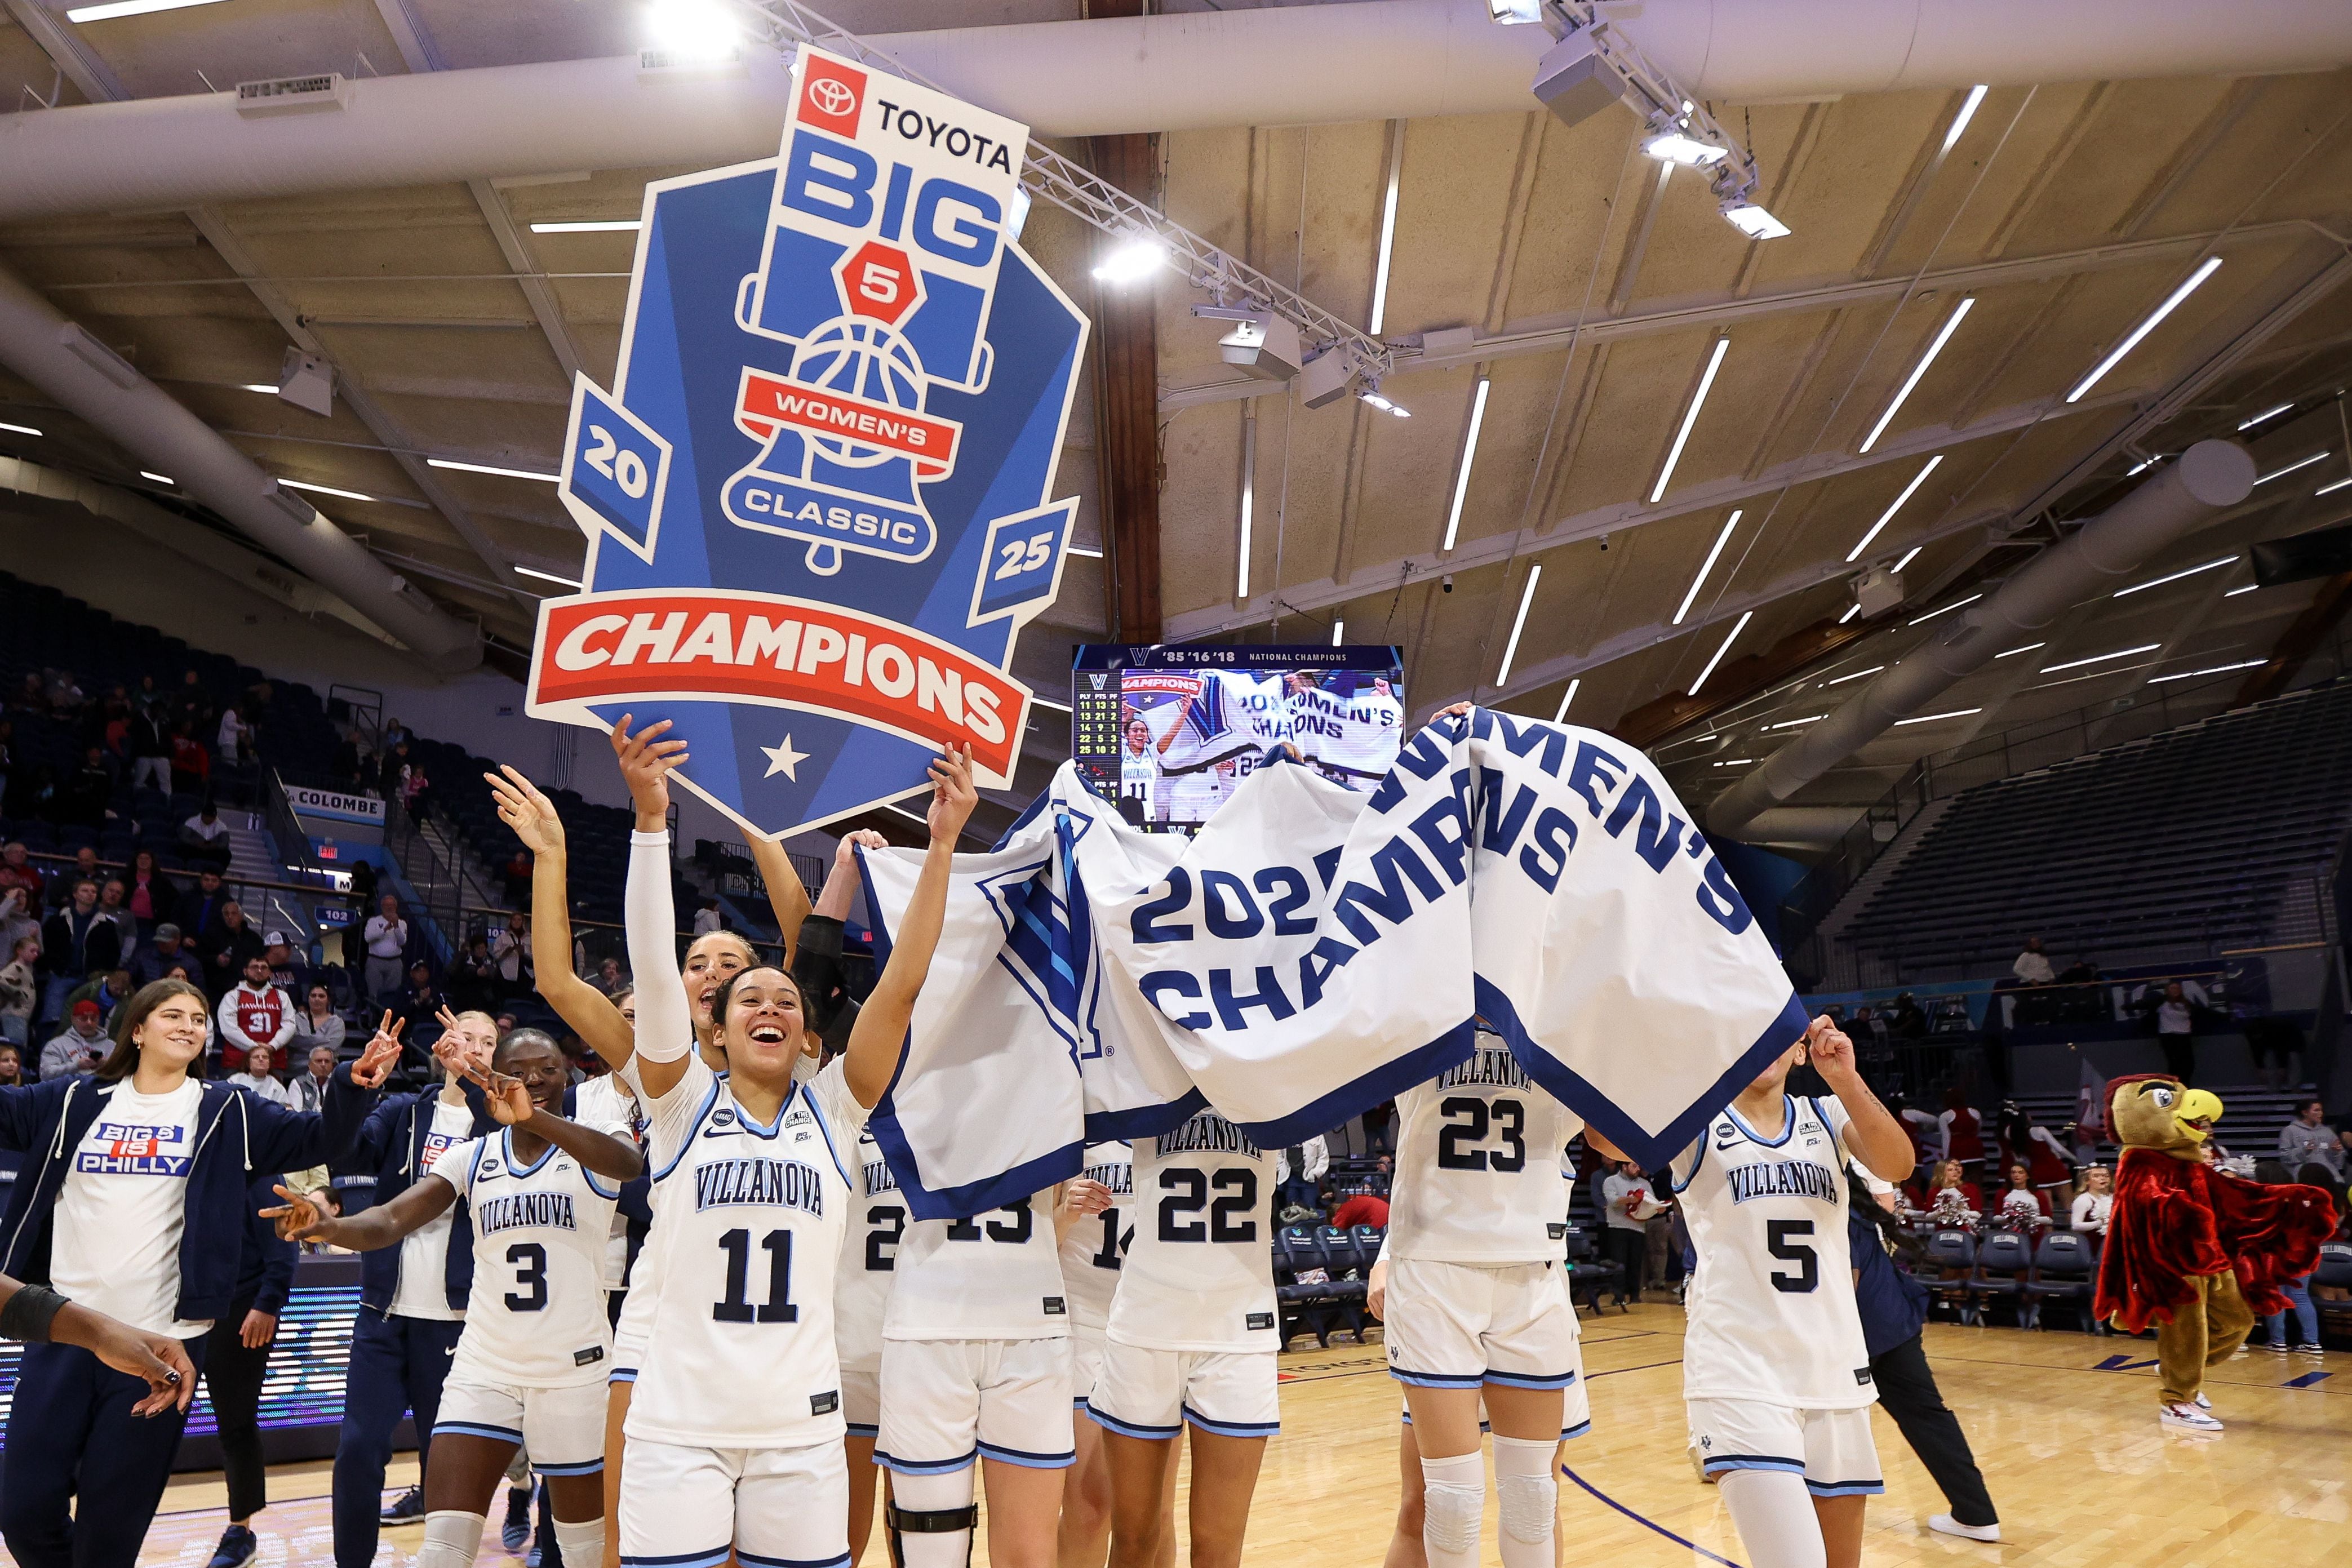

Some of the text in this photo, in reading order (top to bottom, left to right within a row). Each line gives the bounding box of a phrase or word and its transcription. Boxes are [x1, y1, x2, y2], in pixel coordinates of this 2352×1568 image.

[877, 99, 1011, 175] TOYOTA
[781, 127, 1002, 268] BIG
[858, 261, 902, 305] 5
[774, 392, 928, 447] WOMEN'S
[584, 424, 649, 500] 20
[744, 487, 917, 546] CLASSIC
[995, 531, 1053, 581] 25
[554, 611, 1006, 746] CHAMPIONS
[1162, 652, 1184, 662] '85
[1188, 652, 1210, 662] '16
[1213, 652, 1235, 662] '18
[299, 791, 378, 814] COLOMBE
[1130, 783, 1147, 801] 11
[326, 910, 348, 921] 102
[1139, 765, 1578, 1032] CHAMPNS
[248, 1012, 271, 1033] 31
[102, 1125, 175, 1142] BIG 5
[715, 1112, 732, 1122] MMG
[784, 1117, 811, 1129] CHANGE
[1438, 1096, 1525, 1173] 23
[82, 1155, 186, 1174] PHILLY
[119, 1141, 149, 1156] IS
[694, 1157, 823, 1221] VILLANOVA
[1158, 1168, 1258, 1243] 22
[1727, 1160, 1839, 1207] VILLANOVA
[479, 1192, 577, 1239] VILLANOVA
[504, 1242, 548, 1312] 3
[712, 1228, 798, 1324] 11
[1767, 1219, 1819, 1294] 5
